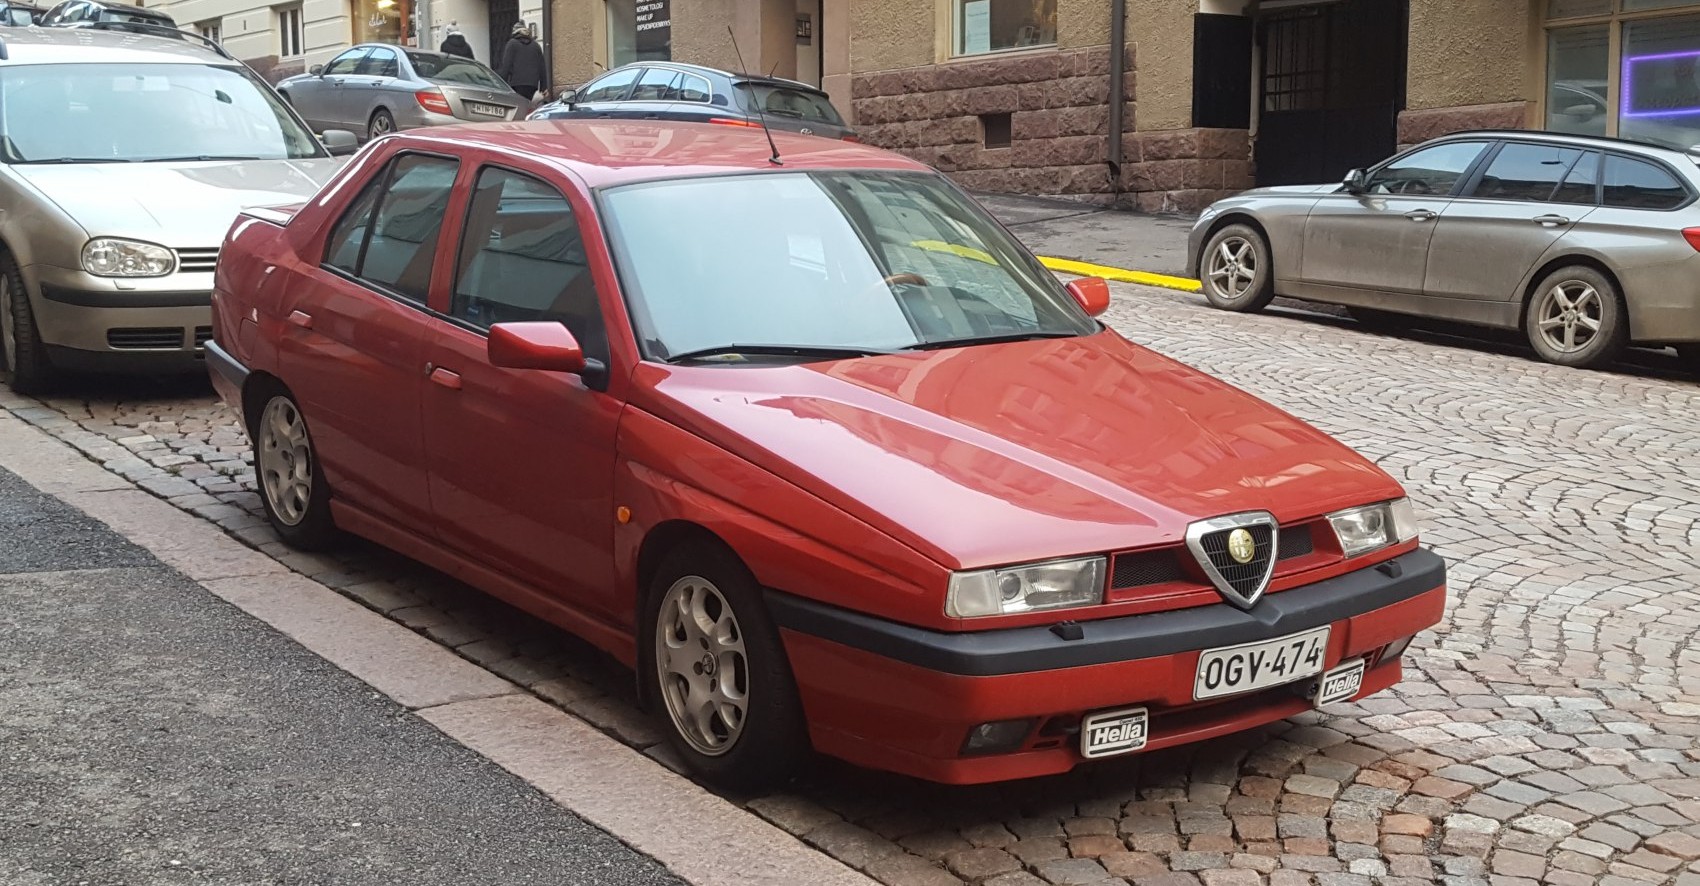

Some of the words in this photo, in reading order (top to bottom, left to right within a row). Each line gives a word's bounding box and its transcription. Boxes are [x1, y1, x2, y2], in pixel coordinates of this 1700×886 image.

[636, 14, 647, 22] MAKE
[1205, 637, 1319, 690] OGV-474
[1325, 674, 1359, 696] Hella
[1093, 723, 1142, 745] Hella
